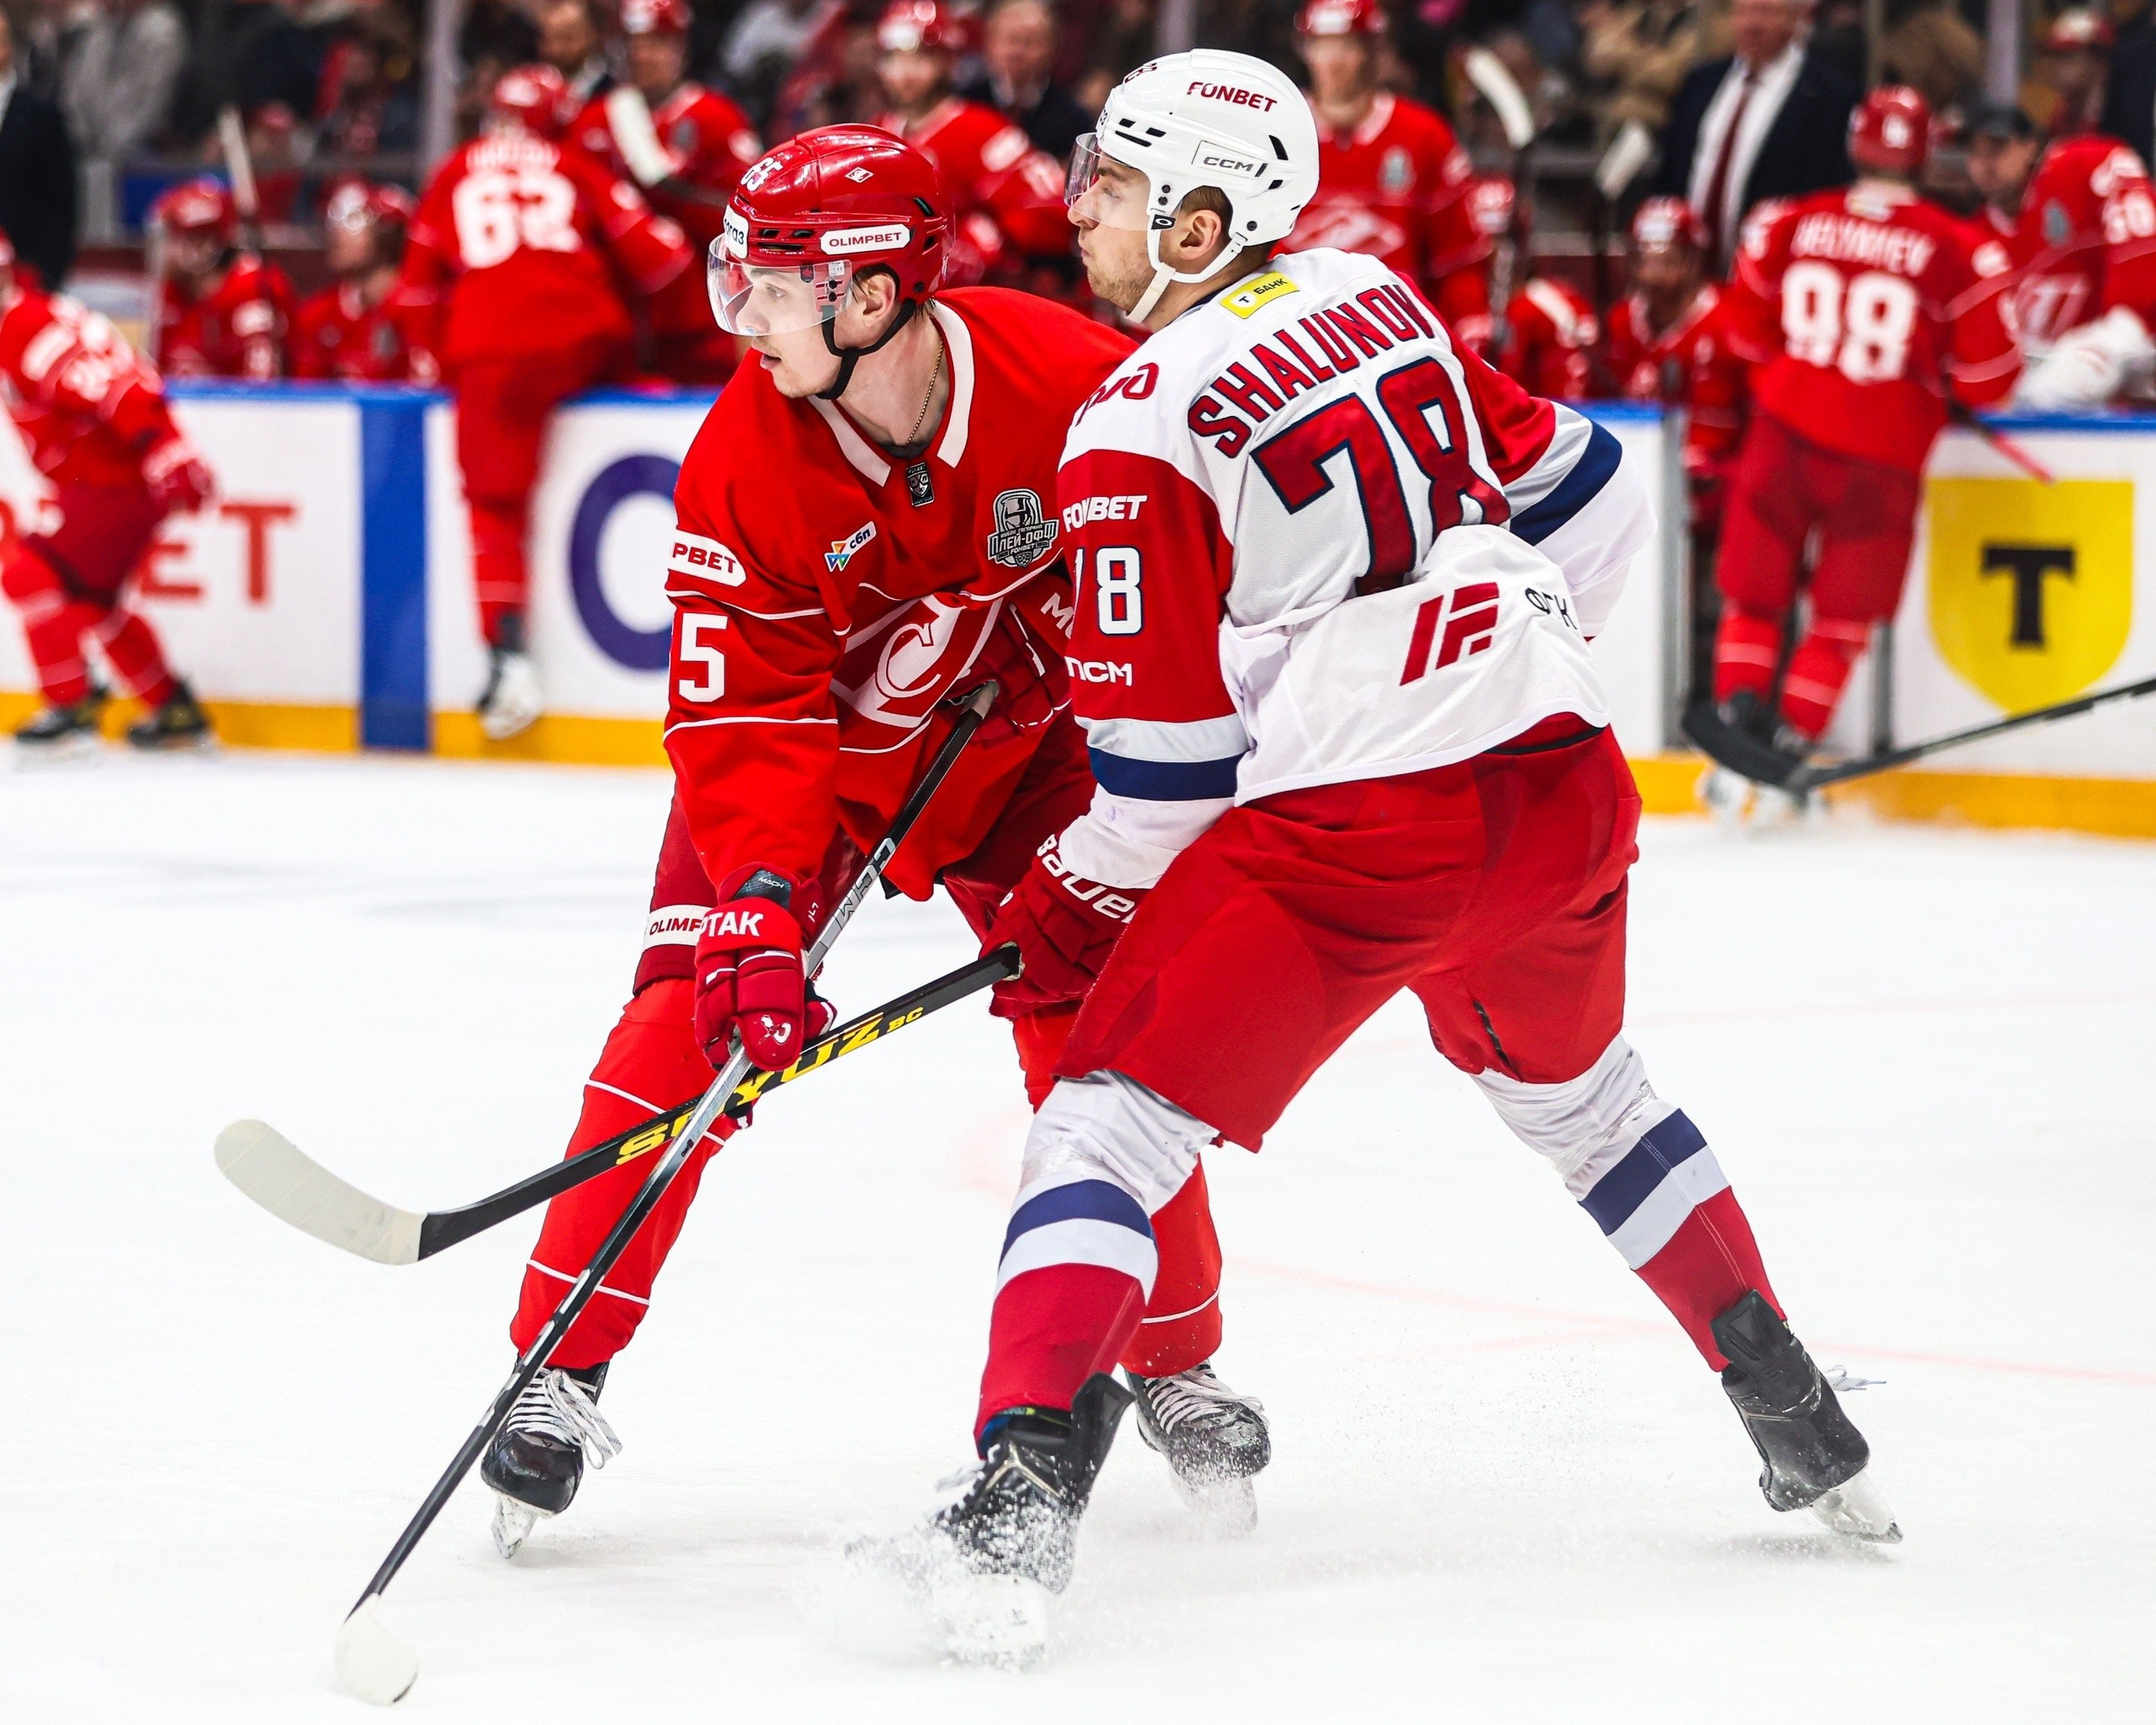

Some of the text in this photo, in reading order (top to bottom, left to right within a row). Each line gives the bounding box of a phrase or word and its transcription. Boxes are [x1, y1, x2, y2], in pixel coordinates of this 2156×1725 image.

[1187, 81, 1278, 112] FONBET
[1203, 157, 1253, 172] CCM
[829, 232, 903, 248] OLIMPBET
[1253, 278, 1288, 295] БАНК
[1187, 285, 1435, 459] SHALUNOV
[1249, 355, 1511, 596] 78
[991, 522, 1055, 556] ПЛЕЙ-ОФФ
[758, 877, 785, 889] MACH
[886, 1007, 924, 1033] BC
